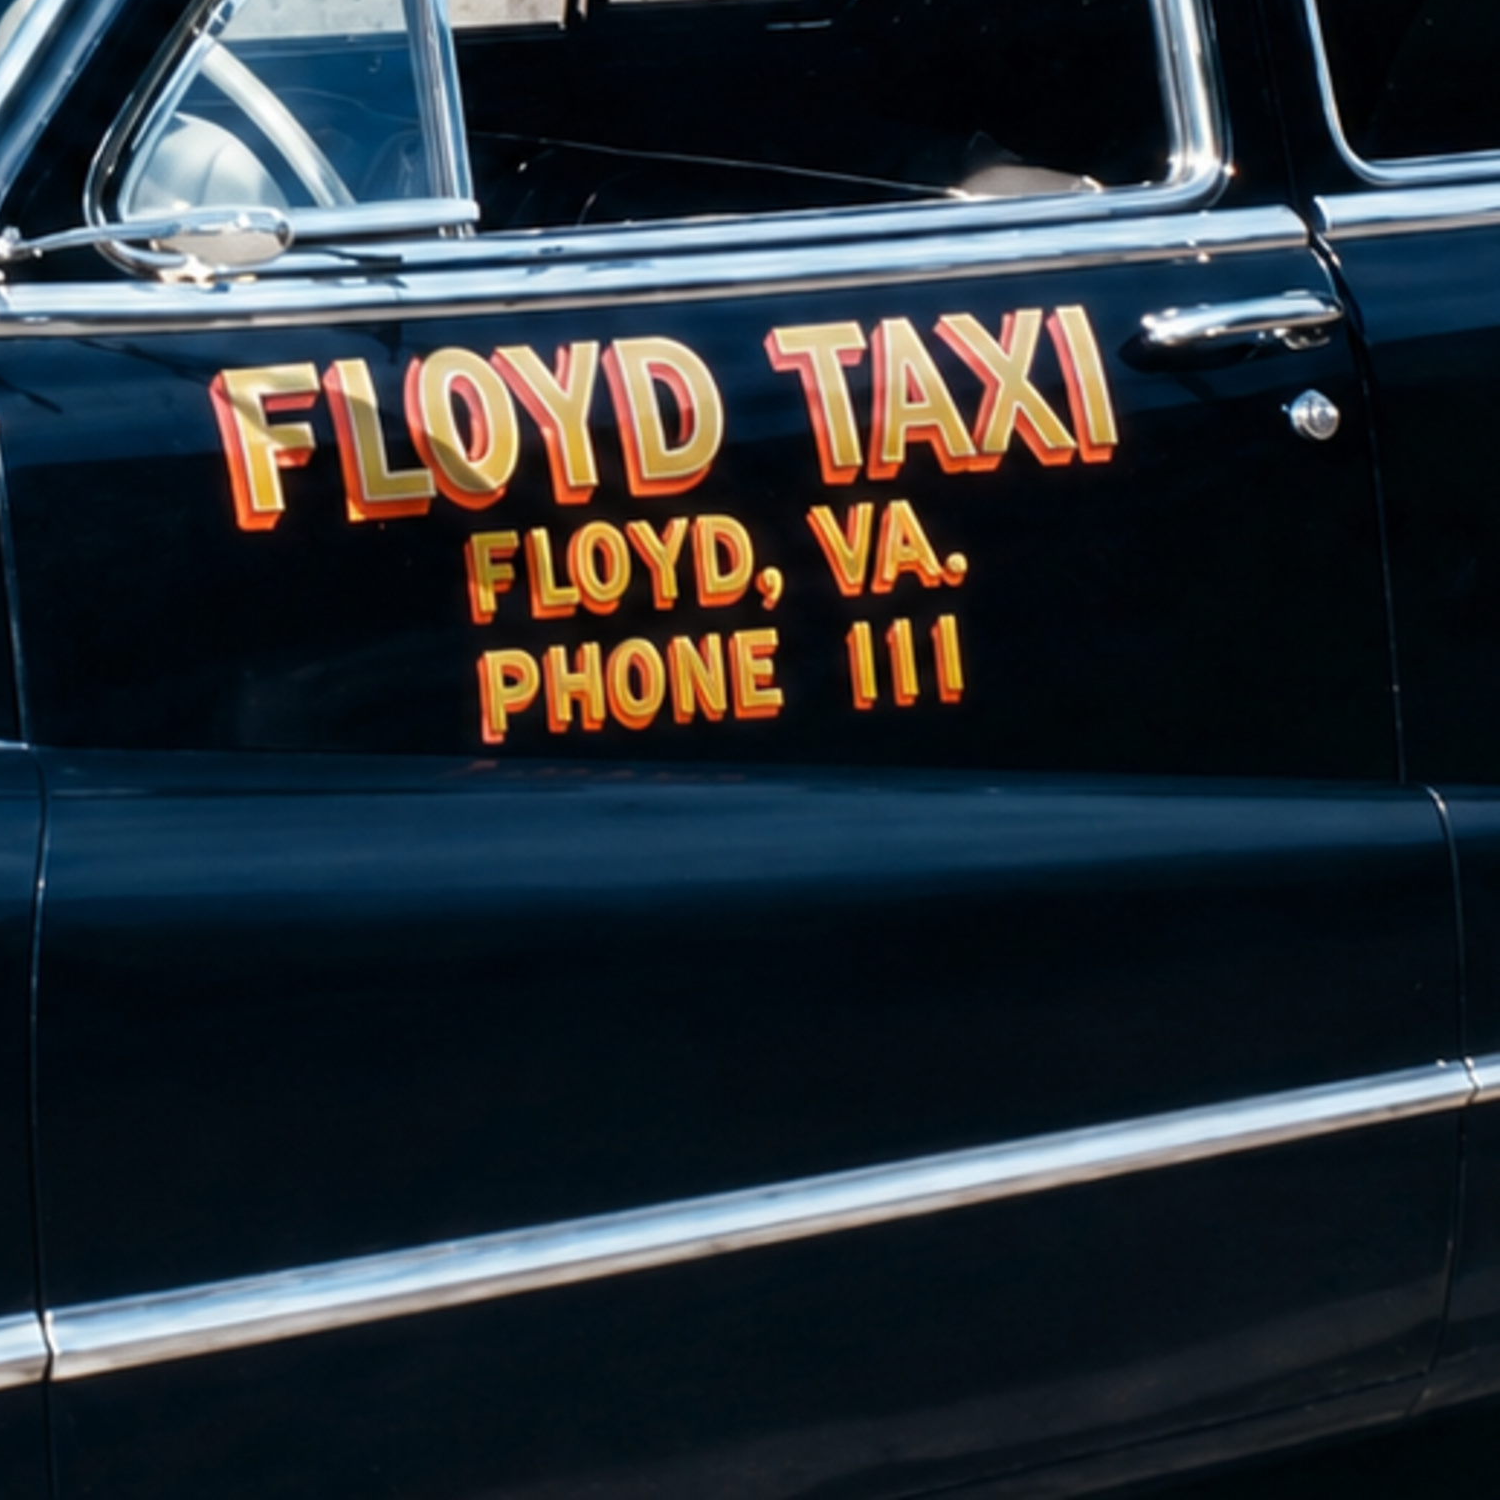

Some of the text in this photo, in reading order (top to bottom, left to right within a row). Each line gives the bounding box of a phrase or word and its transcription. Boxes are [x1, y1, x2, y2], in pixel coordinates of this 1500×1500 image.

[211, 305, 1118, 529] FLOYD TAXI
[465, 500, 968, 623] FLOYD, VA.
[477, 629, 784, 744] PHONE
